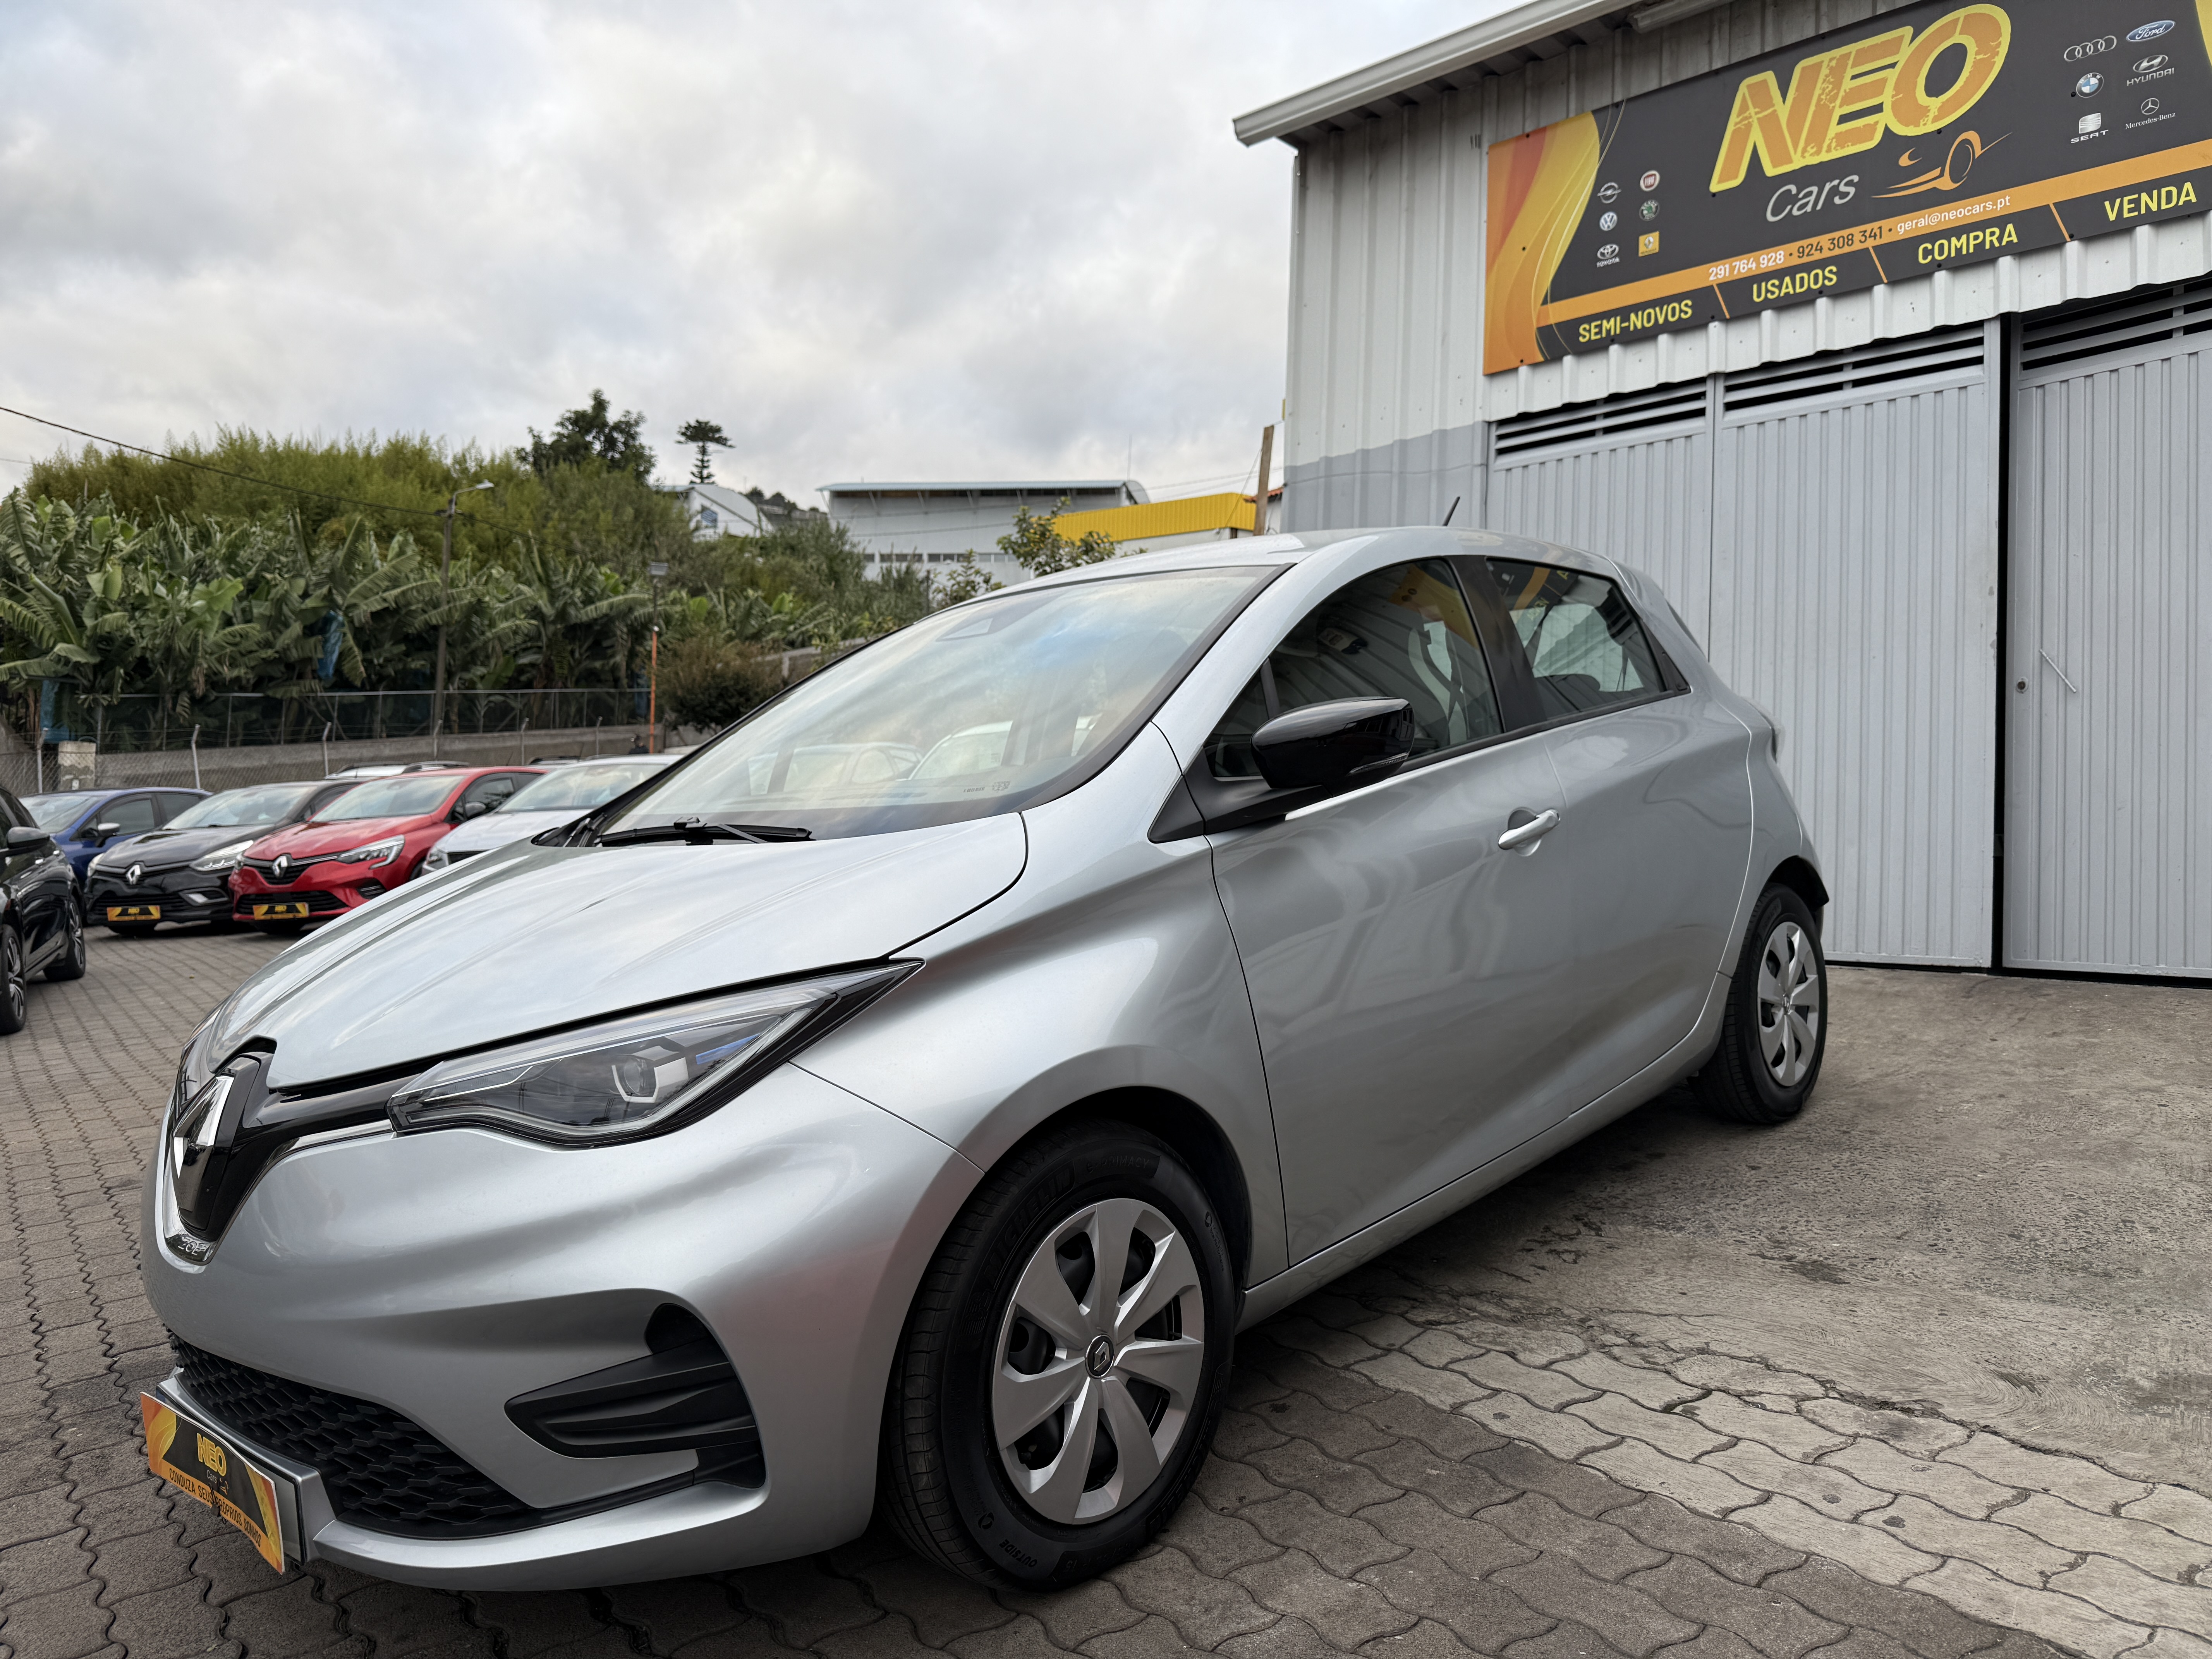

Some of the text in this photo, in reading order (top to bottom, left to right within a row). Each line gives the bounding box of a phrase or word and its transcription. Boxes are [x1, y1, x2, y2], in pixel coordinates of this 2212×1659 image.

[2135, 24, 2166, 40] Ford
[2127, 67, 2174, 86] HYUNDAI
[1709, 3, 2011, 192] NEO
[2071, 129, 2109, 144] SEAT
[2125, 112, 2176, 130] Mercedes-Benz
[1766, 175, 1859, 222] Cars
[2104, 182, 2197, 221] VENDA
[1709, 195, 2011, 281] 291 764 928 924 308 341 geral@neocars.pt
[1918, 223, 2018, 264] COMPRA
[1752, 265, 1837, 302] USADOS
[1579, 299, 1693, 342] SEMI-NOVOS
[984, 1168, 1070, 1285] MICHELIN
[197, 1433, 227, 1476] NEO
[207, 1470, 217, 1484] Cars
[169, 1468, 196, 1495] CONDUZA
[198, 1485, 214, 1505] SEUS
[244, 1518, 261, 1548] SONHOS
[999, 1539, 1038, 1568] OUTSIDE
